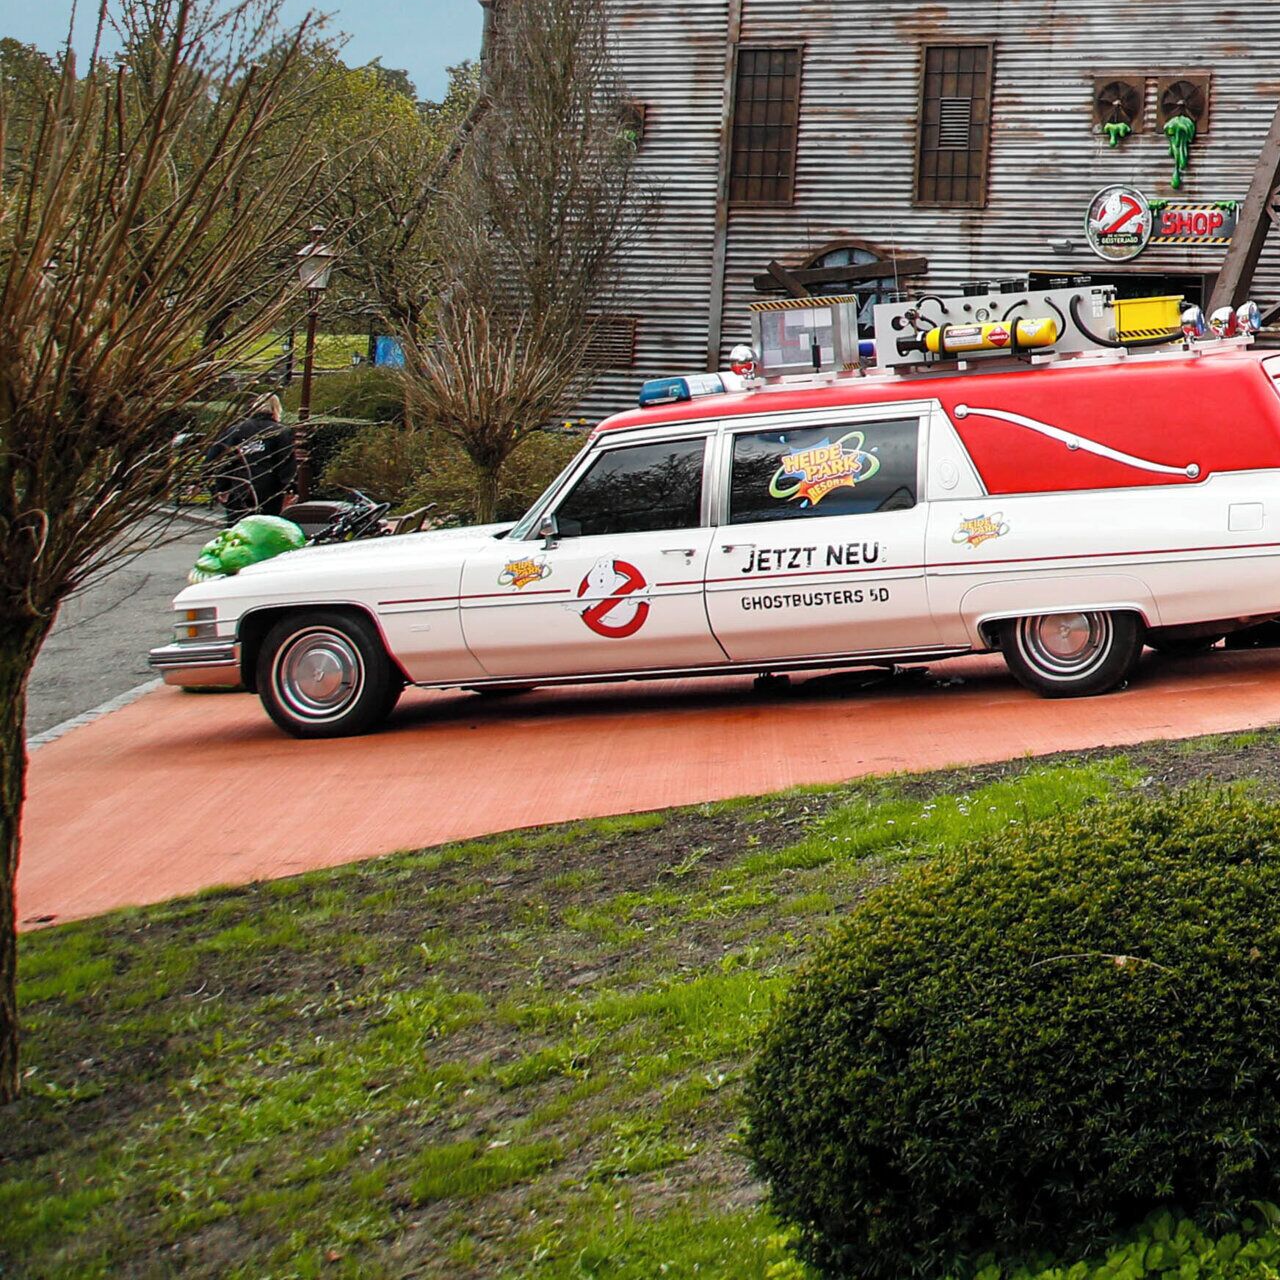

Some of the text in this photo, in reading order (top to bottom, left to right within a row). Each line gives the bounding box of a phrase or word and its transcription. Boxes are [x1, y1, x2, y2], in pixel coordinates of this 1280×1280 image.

[1161, 212, 1224, 236] SHOP
[783, 444, 842, 474] HEIDE
[804, 453, 861, 482] PARK
[742, 546, 817, 574] JETZT
[741, 588, 890, 611] GHOSTBUSTERS 5D
